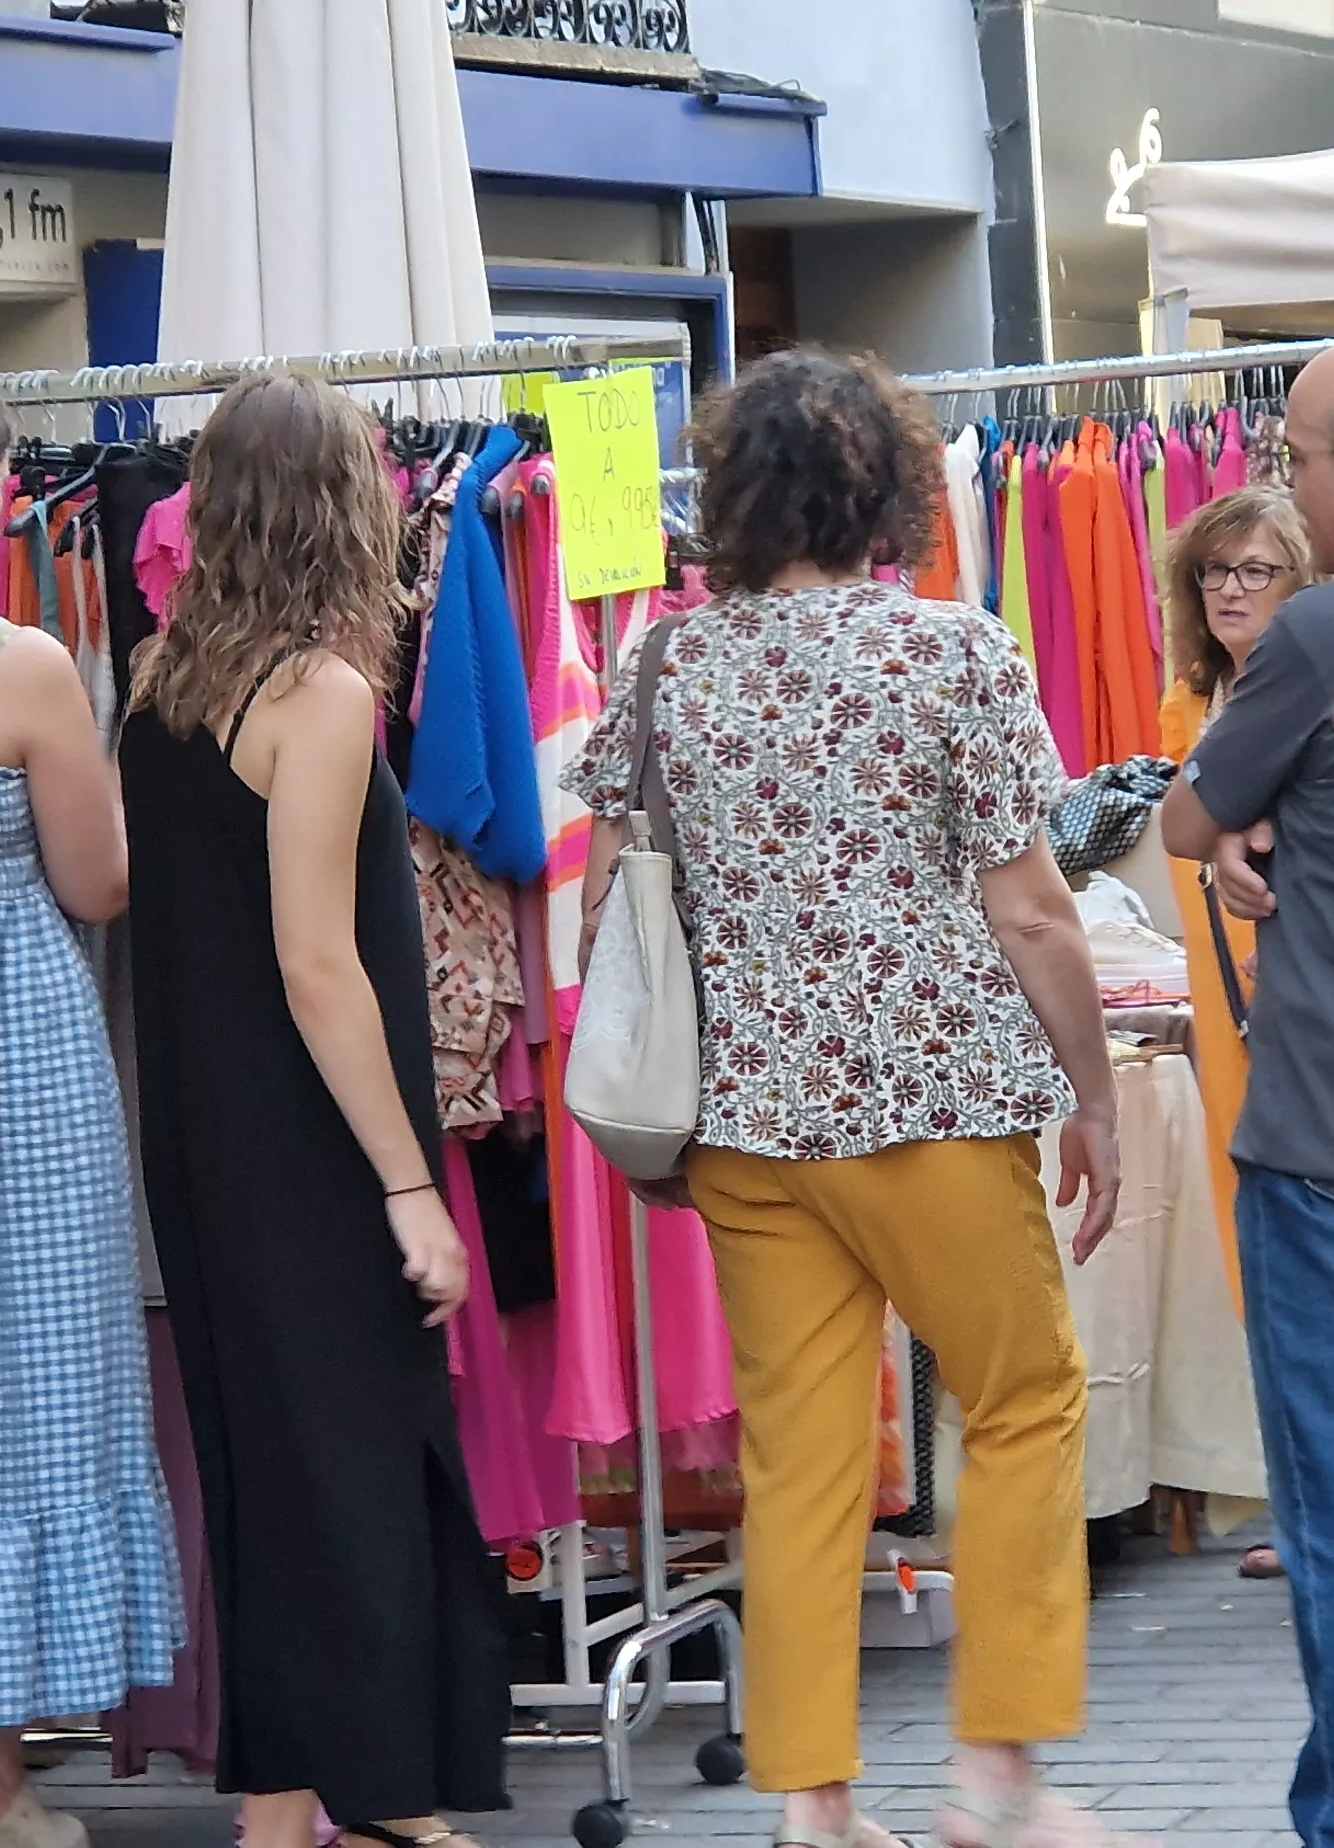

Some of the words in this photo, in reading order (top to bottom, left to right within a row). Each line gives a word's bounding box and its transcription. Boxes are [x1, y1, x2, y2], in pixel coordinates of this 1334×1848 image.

[28, 187, 67, 243] fm
[576, 387, 641, 434] TODO
[602, 446, 616, 483] A
